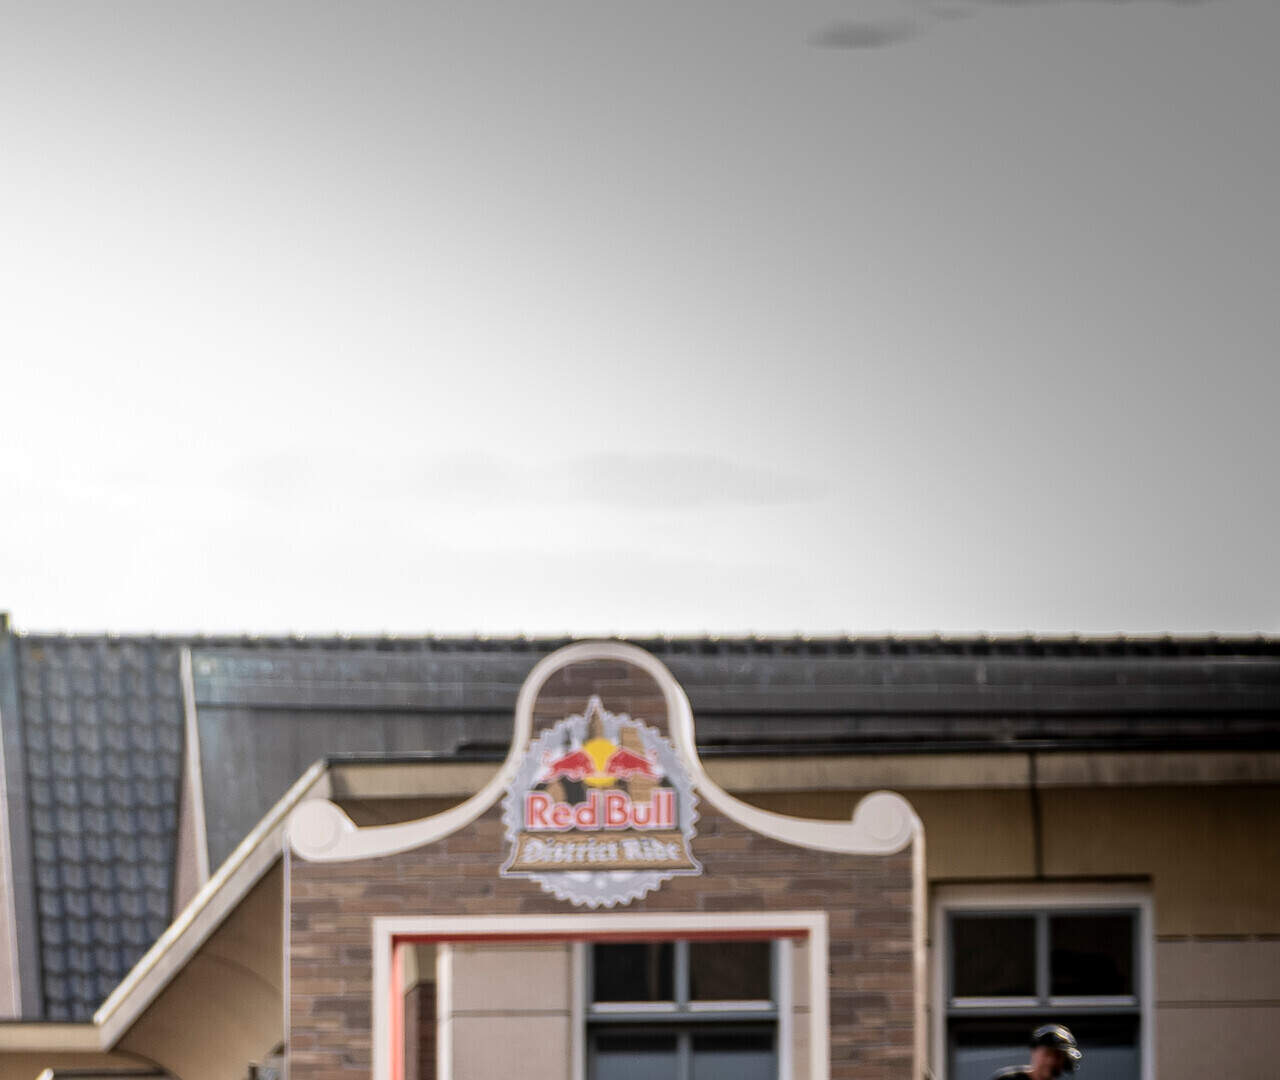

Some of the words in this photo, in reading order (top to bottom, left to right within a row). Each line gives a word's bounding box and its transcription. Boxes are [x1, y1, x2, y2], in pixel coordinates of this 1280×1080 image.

[526, 792, 598, 829] Red
[604, 790, 675, 828] Bull
[521, 837, 618, 864] District
[619, 836, 682, 864] Ride
